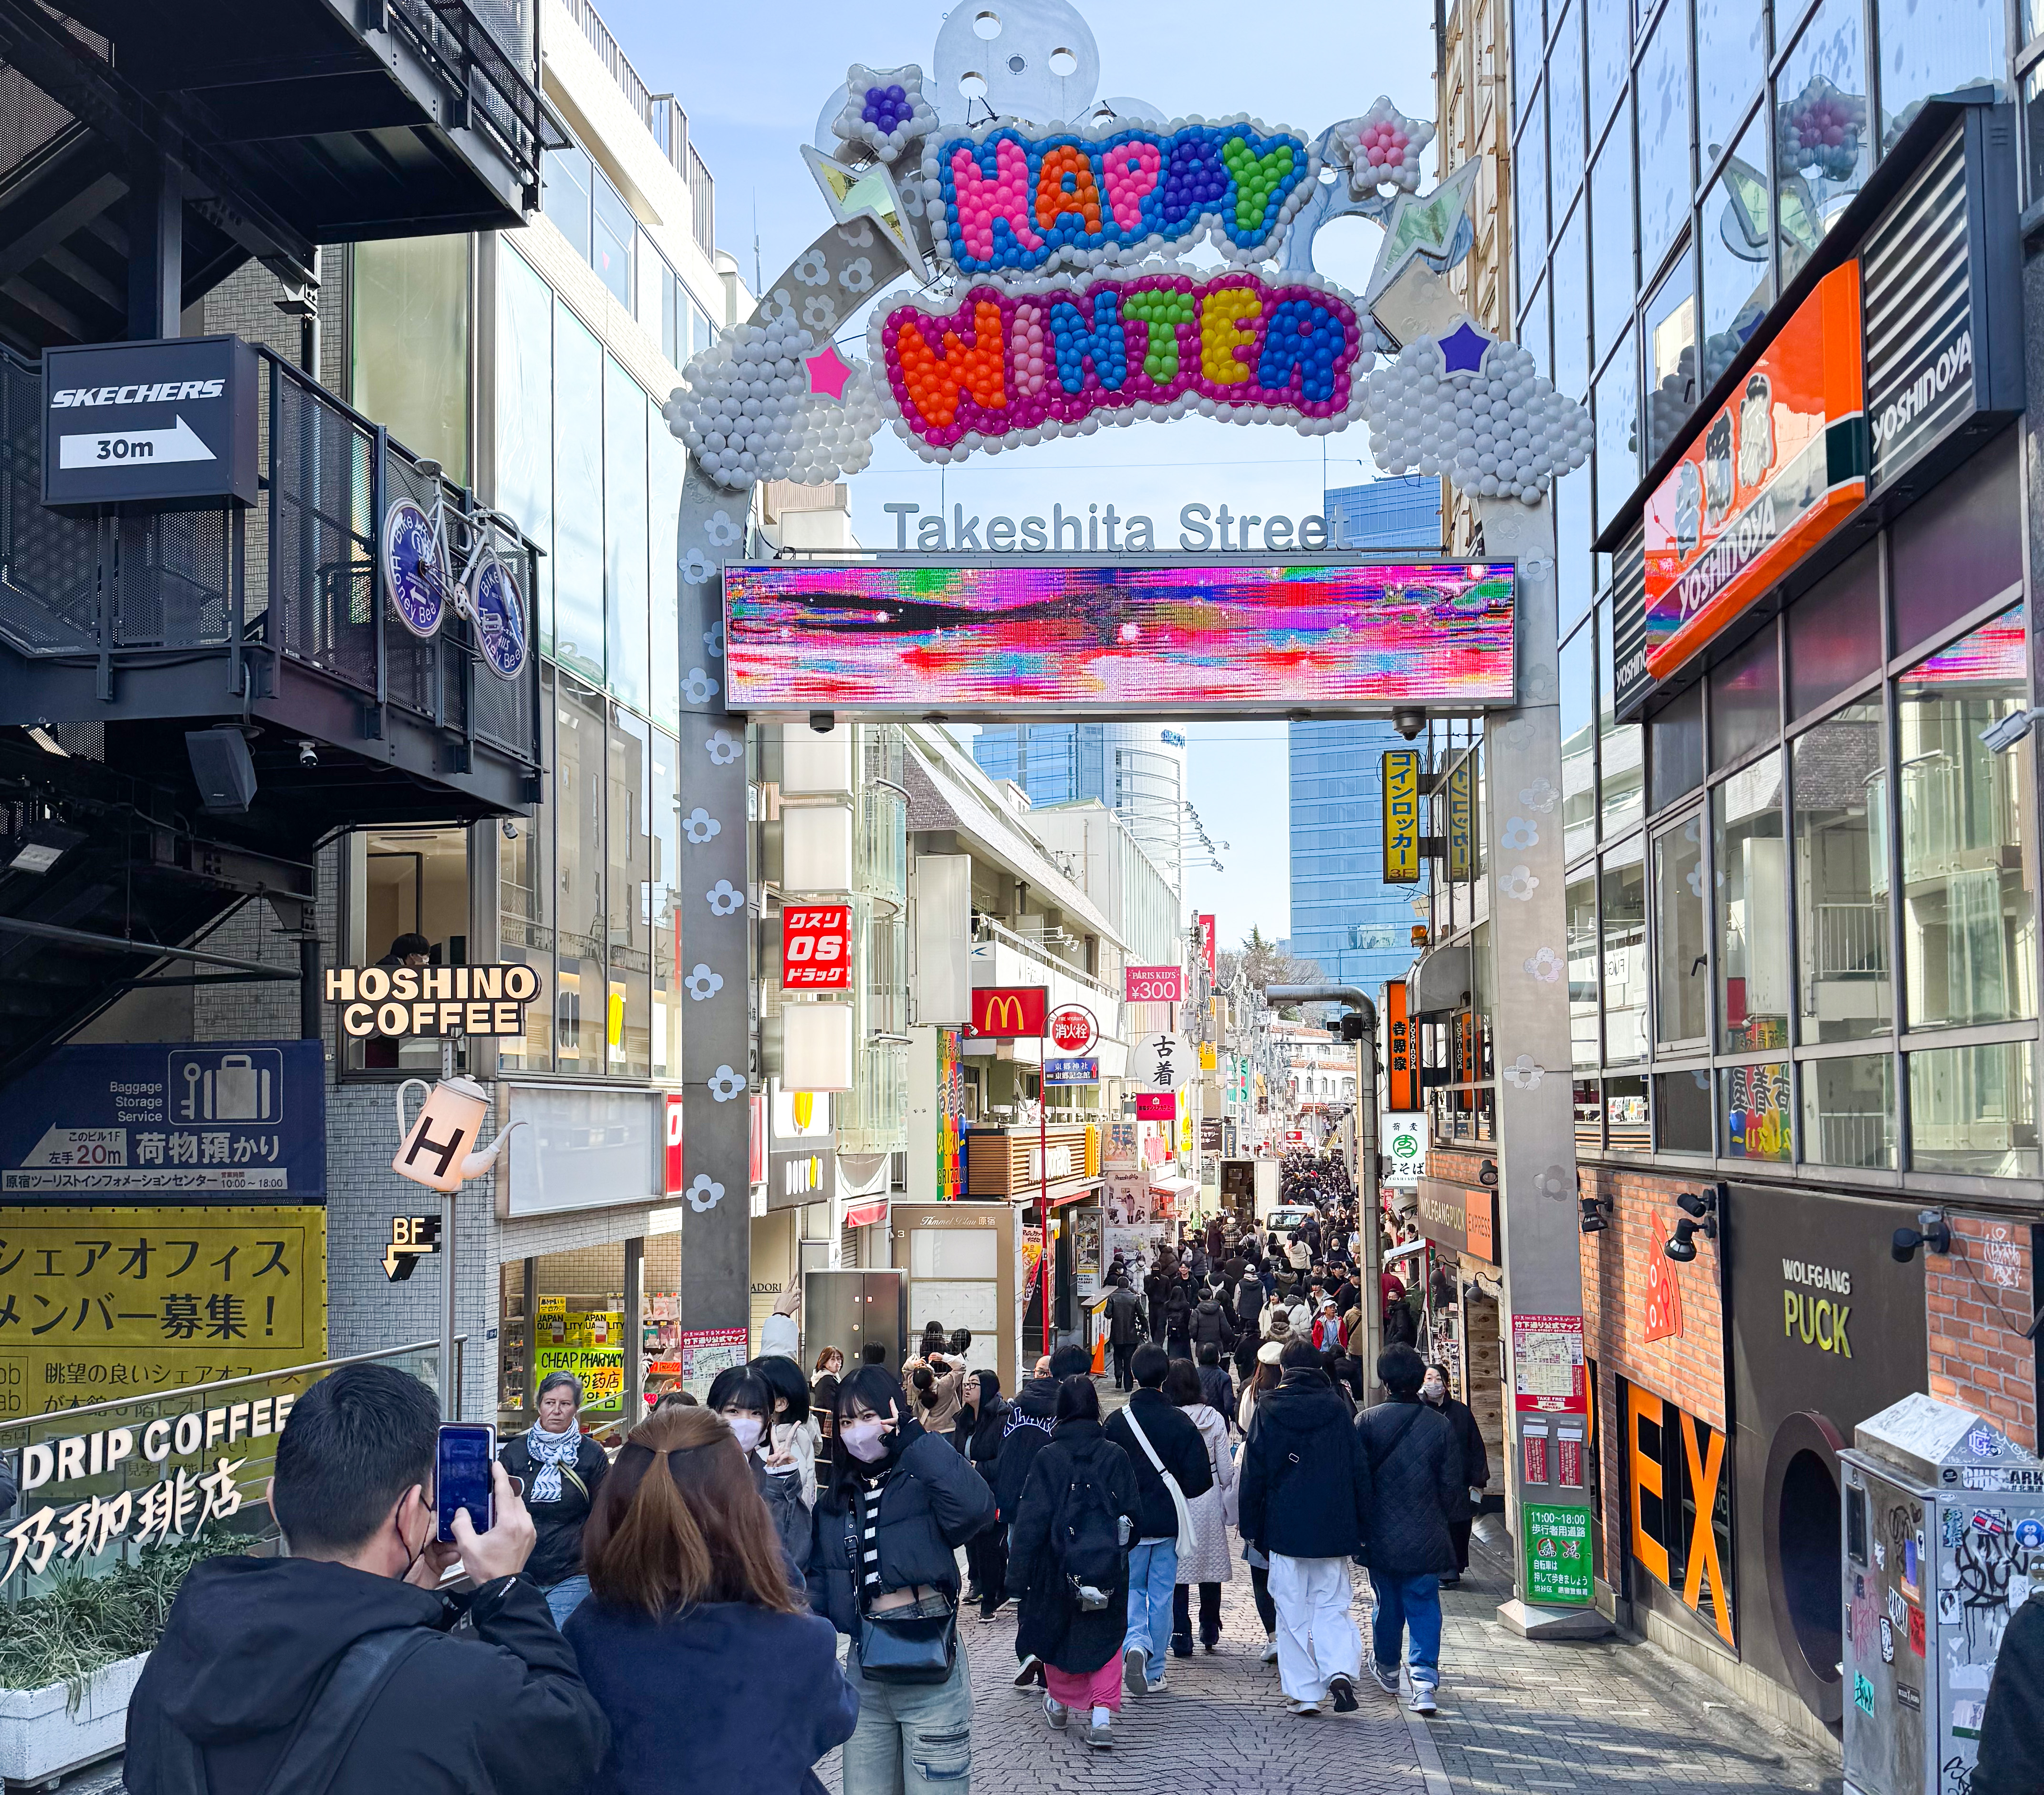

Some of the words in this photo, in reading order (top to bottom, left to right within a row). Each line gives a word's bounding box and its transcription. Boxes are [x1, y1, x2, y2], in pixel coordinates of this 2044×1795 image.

[952, 137, 1294, 261] HAPPY
[898, 288, 1346, 428] WINTER
[51, 379, 226, 408] SKECHERS
[1872, 329, 1972, 454] YOSHINOYA
[96, 438, 154, 460] 30m
[884, 502, 1155, 553] Takeshita
[1179, 502, 1353, 552] Street
[1679, 495, 1775, 623] YOSHINOYA
[1390, 753, 1415, 865] コインロッカー
[1390, 868, 1416, 878] 3F
[789, 913, 841, 929] クスリ
[787, 935, 843, 961] OS
[326, 966, 536, 1001] HOSHINO
[787, 967, 844, 982] ドラッグ
[1132, 970, 1155, 979] PARIS
[1156, 971, 1177, 979] KID'S
[1131, 981, 1176, 999] ¥300
[344, 1001, 521, 1036] COFFEE
[1055, 1023, 1088, 1039] 消火栓
[1152, 1035, 1176, 1086] 古着
[110, 1081, 163, 1093] Baggage
[115, 1096, 163, 1108] Storage
[118, 1111, 163, 1122] Service
[69, 1131, 121, 1142] このビル1F
[136, 1131, 280, 1164] 荷物預かり
[405, 1116, 465, 1177] H
[49, 1145, 121, 1165] 左手20m
[6, 1174, 218, 1189] 原宿ツーリストインフォメーションセンター
[785, 1154, 824, 1195] DOUTOR
[937, 1166, 967, 1186] GRIZZLY
[393, 1217, 425, 1245] BF
[979, 1216, 996, 1225] 原宿
[1468, 1213, 1491, 1238] EXPRESS
[0, 1237, 291, 1282] シェアオフィス
[1782, 1258, 1851, 1295] WOLFGANG
[537, 1314, 564, 1322] JAPAN
[1784, 1289, 1852, 1359] PUCK
[542, 1352, 578, 1369] CHEAP
[580, 1352, 624, 1369] PHARMACY
[575, 1370, 620, 1390] 的药店
[21, 1427, 133, 1491] DRIP
[142, 1393, 295, 1463] COFFEE
[1627, 1380, 1734, 1647] EX
[1532, 1525, 1585, 1537] 歩行者用道路
[1533, 1559, 1558, 1570] 自転車は
[1534, 1572, 1588, 1586] 押して歩きましょう
